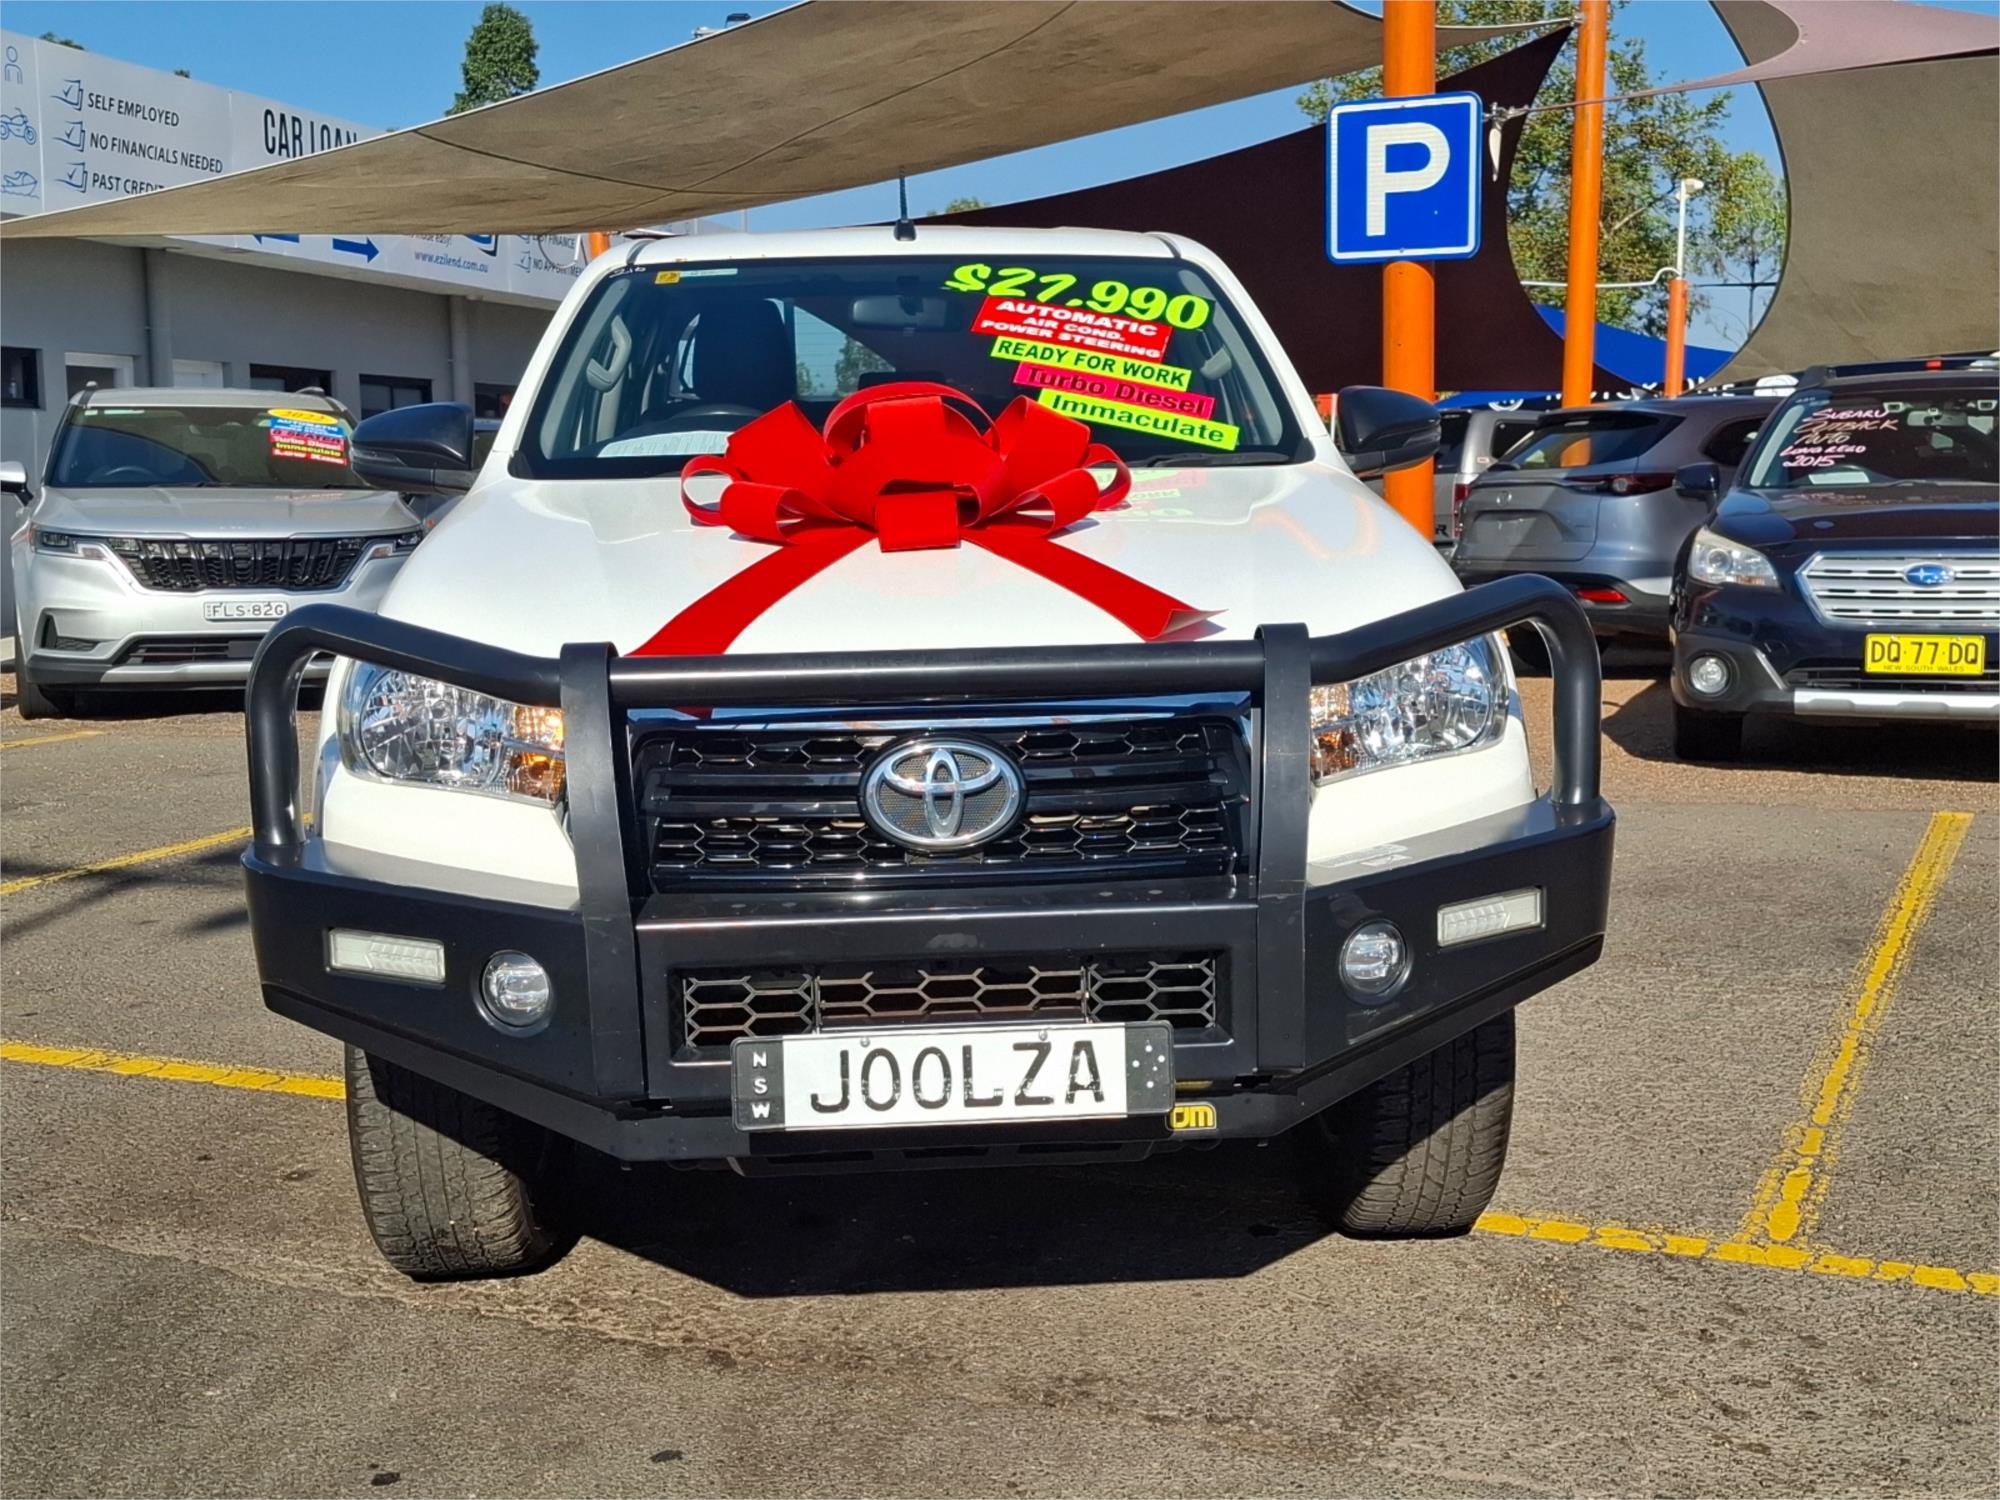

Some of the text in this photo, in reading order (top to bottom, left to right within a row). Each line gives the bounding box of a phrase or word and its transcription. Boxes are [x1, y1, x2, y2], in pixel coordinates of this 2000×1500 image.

[87, 92, 180, 127] SELF EMPLOYED
[90, 131, 223, 174] NO FINANCIALS NEEDED
[263, 108, 303, 158] CAR
[92, 172, 121, 192] PAST
[1366, 121, 1450, 237] P
[980, 319, 1162, 359] POWER STEERING
[996, 300, 1158, 337] AUTOMATIC
[1023, 316, 1126, 342] AIR COND.
[997, 340, 1187, 388] READY FOR WORK
[1028, 367, 1206, 416] Turbo Diesel
[1051, 394, 1225, 443] Immaculate
[1803, 408, 1889, 422] SUBARU
[1782, 454, 1845, 467] 2015
[810, 1040, 1105, 1114] JOOLZA
